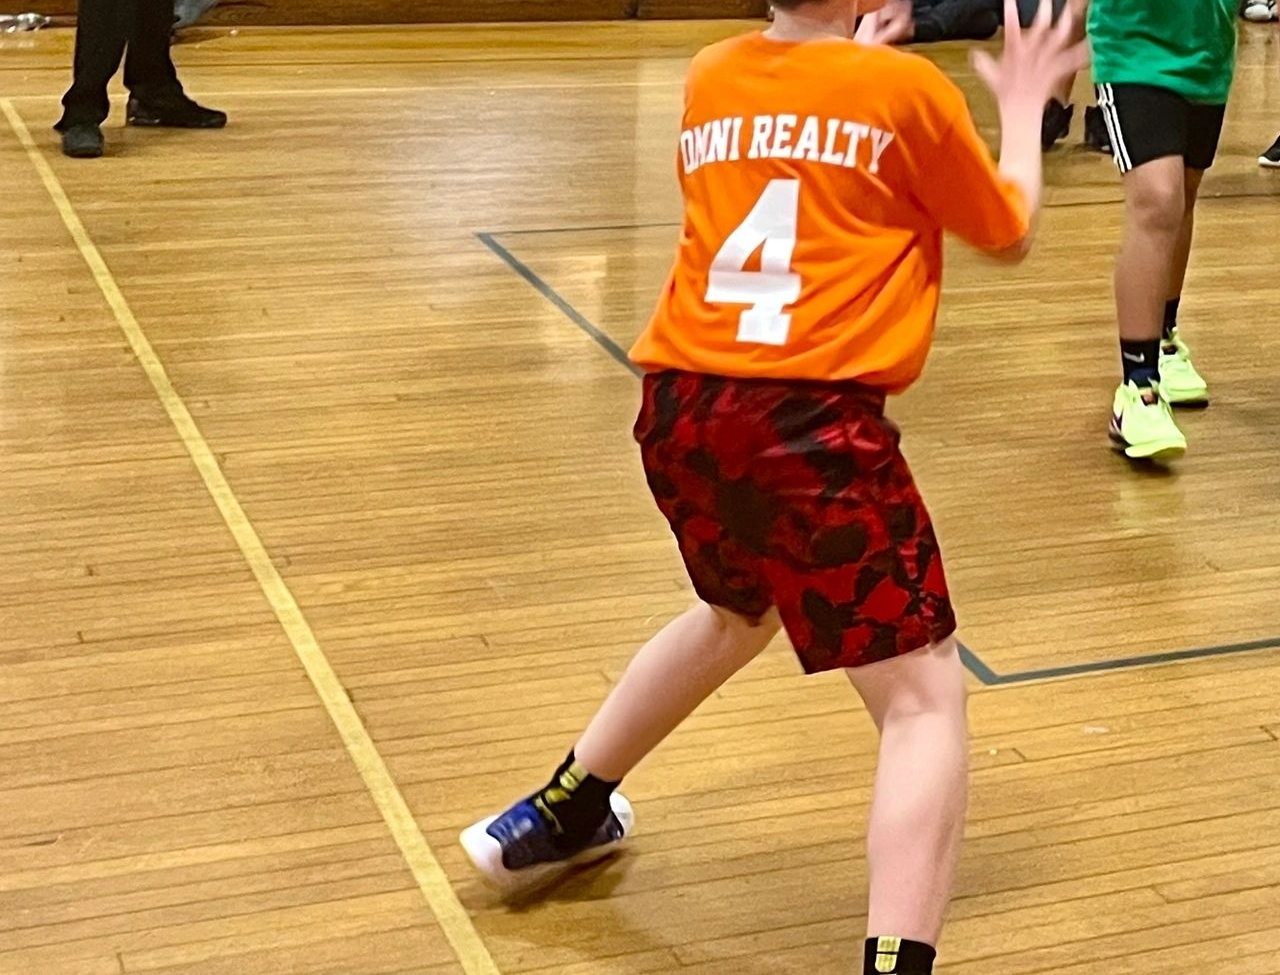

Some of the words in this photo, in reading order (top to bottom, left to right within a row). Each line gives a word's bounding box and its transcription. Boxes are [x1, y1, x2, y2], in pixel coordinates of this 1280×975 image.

[680, 117, 743, 175] OMNI
[747, 113, 896, 175] REALTY
[703, 178, 802, 347] 4
